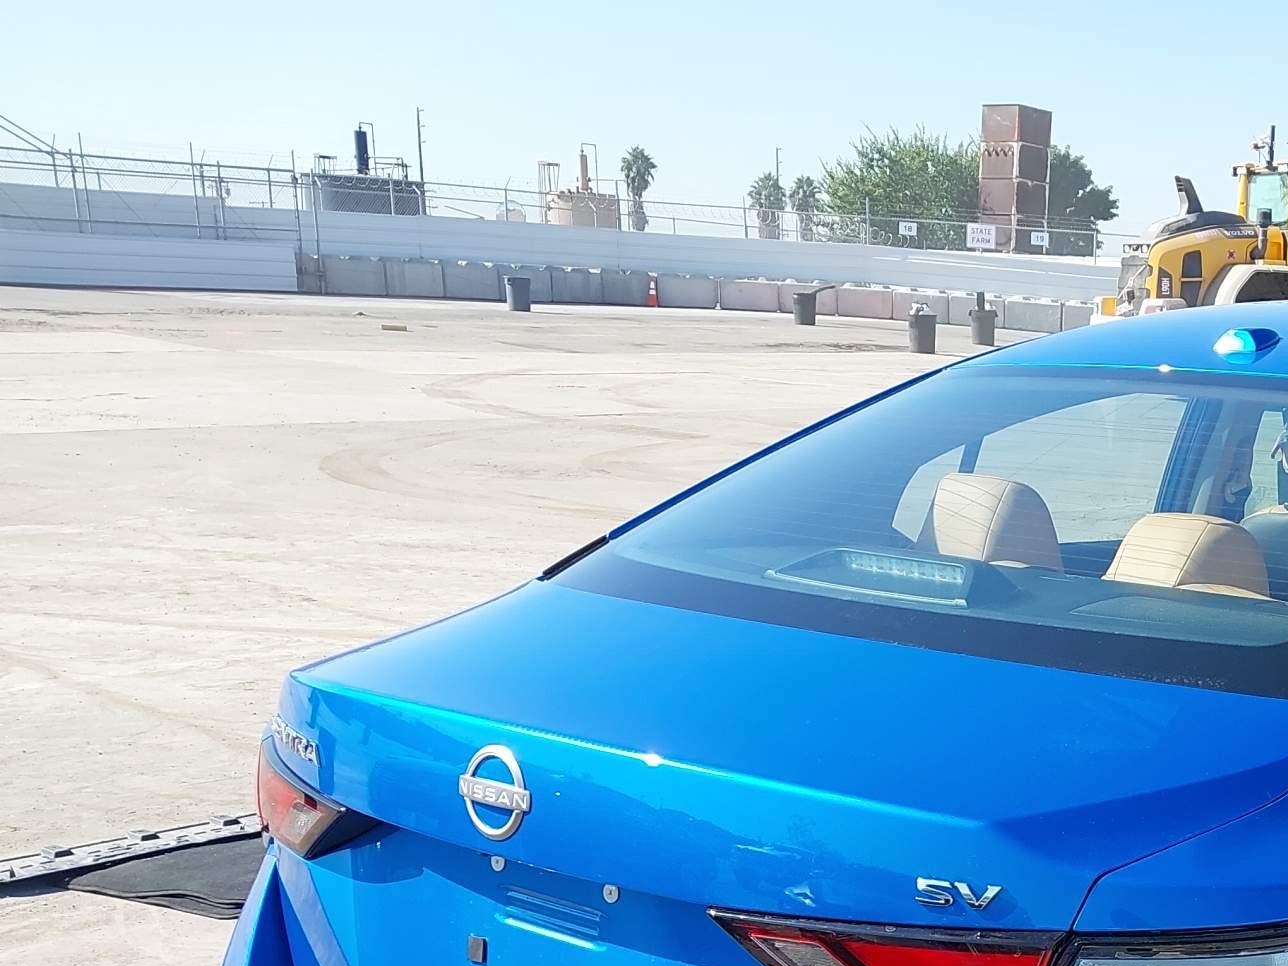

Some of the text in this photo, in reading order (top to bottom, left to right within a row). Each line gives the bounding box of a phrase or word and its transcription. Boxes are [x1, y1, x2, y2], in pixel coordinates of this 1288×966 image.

[971, 227, 992, 236] STATE
[971, 236, 991, 244] FARM
[460, 778, 527, 809] NISSAN
[915, 877, 1002, 910] SV
